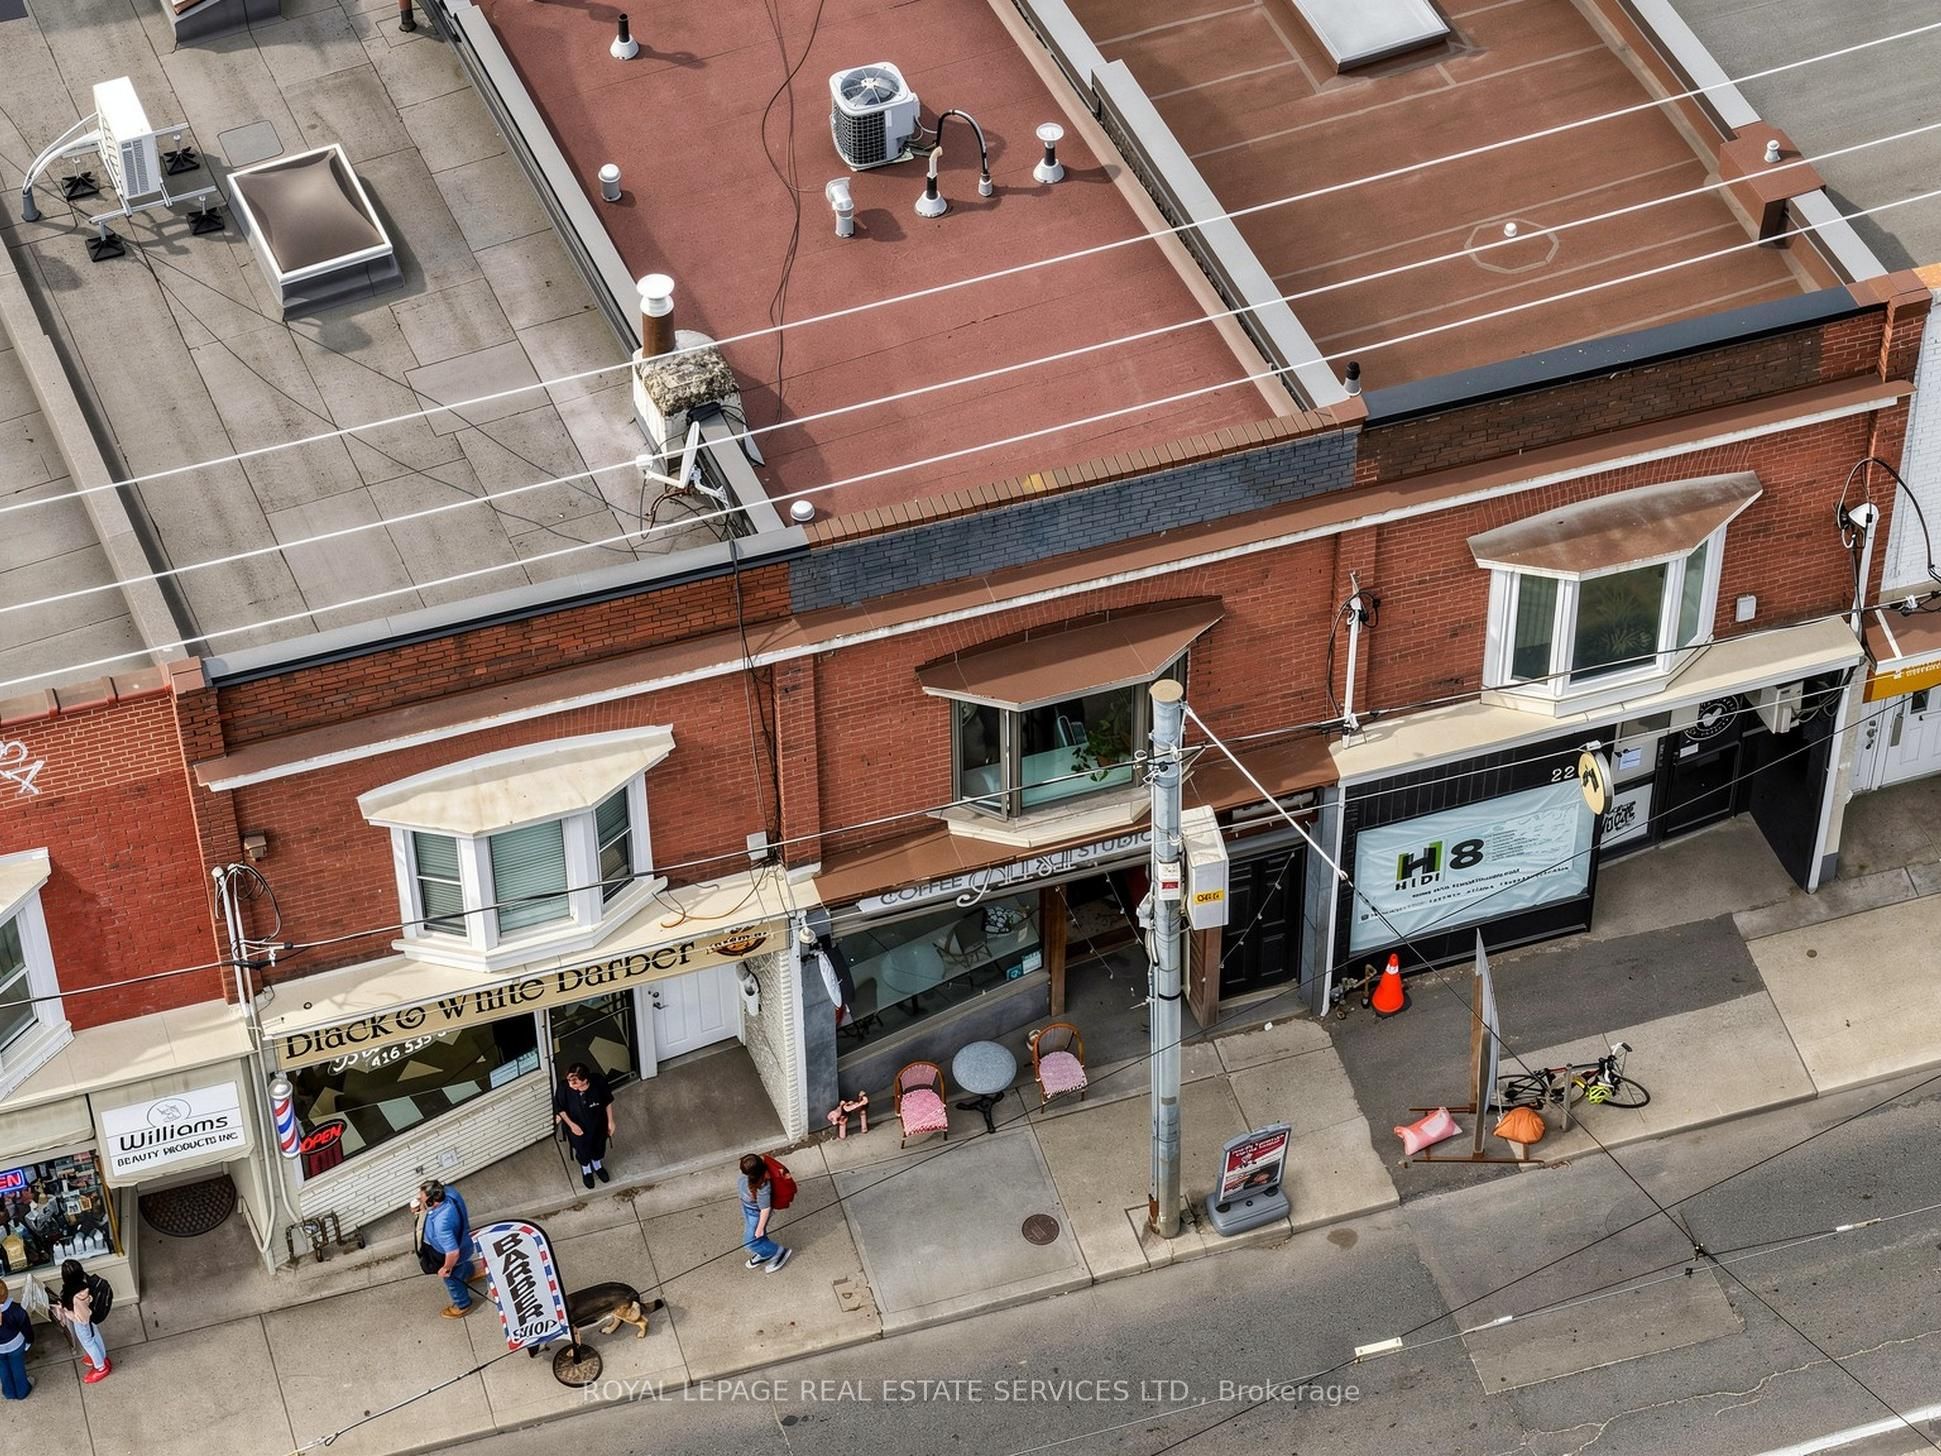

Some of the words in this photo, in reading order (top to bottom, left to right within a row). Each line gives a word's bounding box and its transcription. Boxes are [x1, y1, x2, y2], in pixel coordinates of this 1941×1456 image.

[1395, 873, 1440, 891] HIDI
[371, 1046, 401, 1067] 416
[117, 1149, 160, 1168] BEAUTY
[163, 1136, 217, 1156] PRODUCTS
[219, 1131, 239, 1143] INC
[119, 1115, 229, 1152] Williams
[300, 1123, 343, 1153] OPEN
[492, 1232, 545, 1327] BARBER
